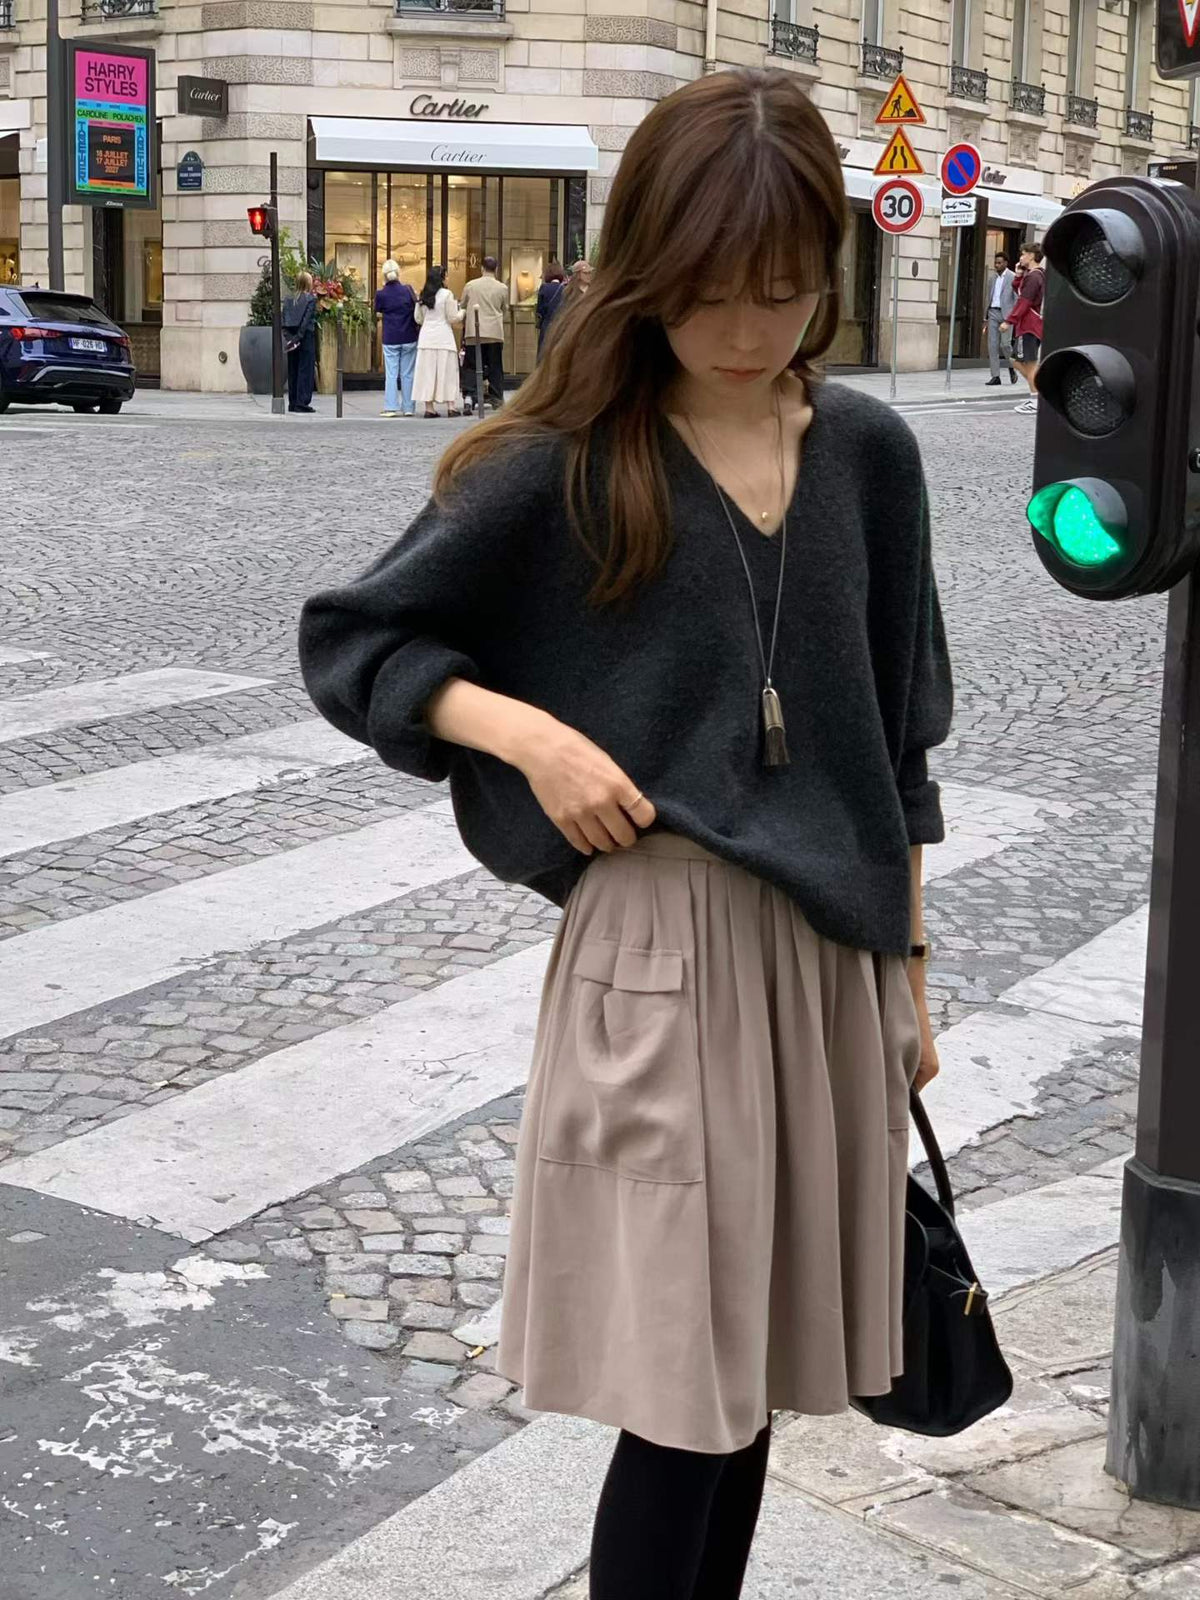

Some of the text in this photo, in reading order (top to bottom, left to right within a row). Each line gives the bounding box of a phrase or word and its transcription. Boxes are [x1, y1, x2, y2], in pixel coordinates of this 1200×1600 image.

[87, 61, 135, 81] HARRY
[84, 76, 138, 97] STYLES
[190, 87, 222, 101] Cartier
[77, 109, 109, 120] CAROLINE
[409, 94, 489, 118] Cartier
[102, 134, 122, 145] PARIS
[430, 144, 487, 162] Cartier
[883, 195, 913, 218] 30
